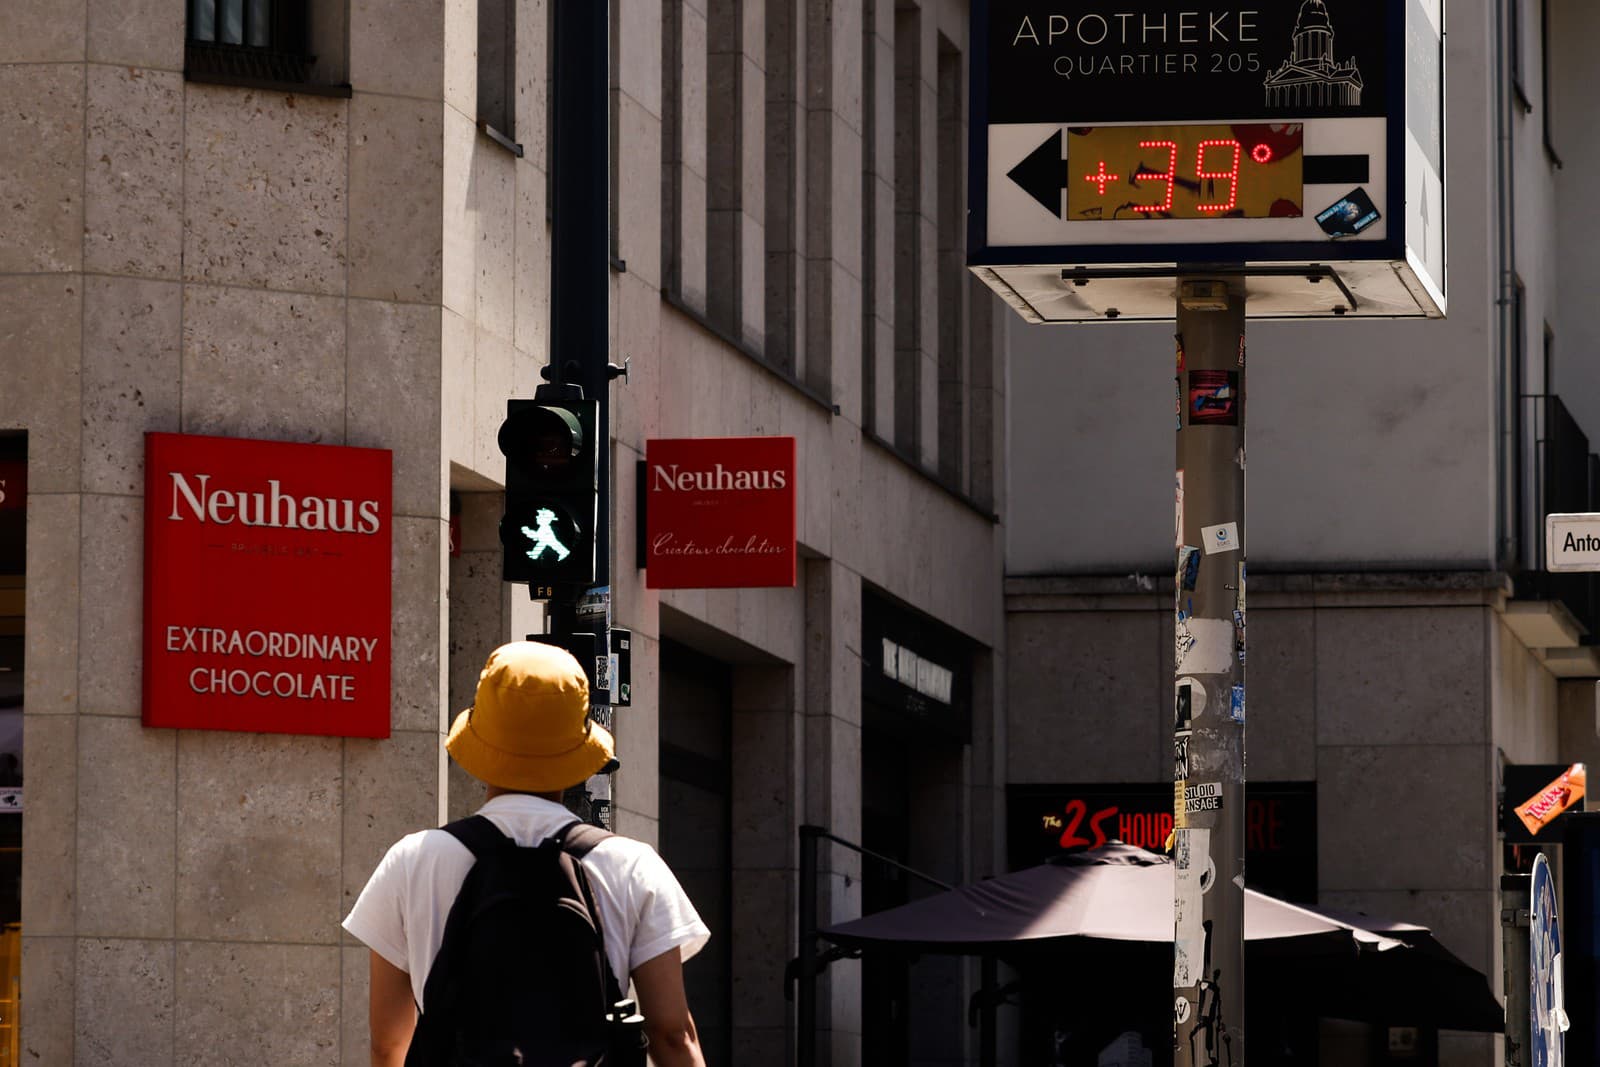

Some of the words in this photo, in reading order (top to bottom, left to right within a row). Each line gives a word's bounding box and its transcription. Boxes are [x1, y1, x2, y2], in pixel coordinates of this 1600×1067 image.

[1012, 10, 1259, 46] APOTHEKE
[1053, 53, 1198, 80] QUARTIER
[1210, 52, 1260, 73] 205
[653, 463, 786, 492] Neuhaus
[168, 472, 380, 534] Neuhaus
[167, 625, 378, 662] EXTRAORDINARY
[189, 667, 355, 701] CHOCOLATE
[1185, 784, 1215, 799] STUDIO
[1185, 797, 1219, 812] ANSAGE
[1525, 786, 1564, 819] Twix
[1060, 799, 1118, 851] 25
